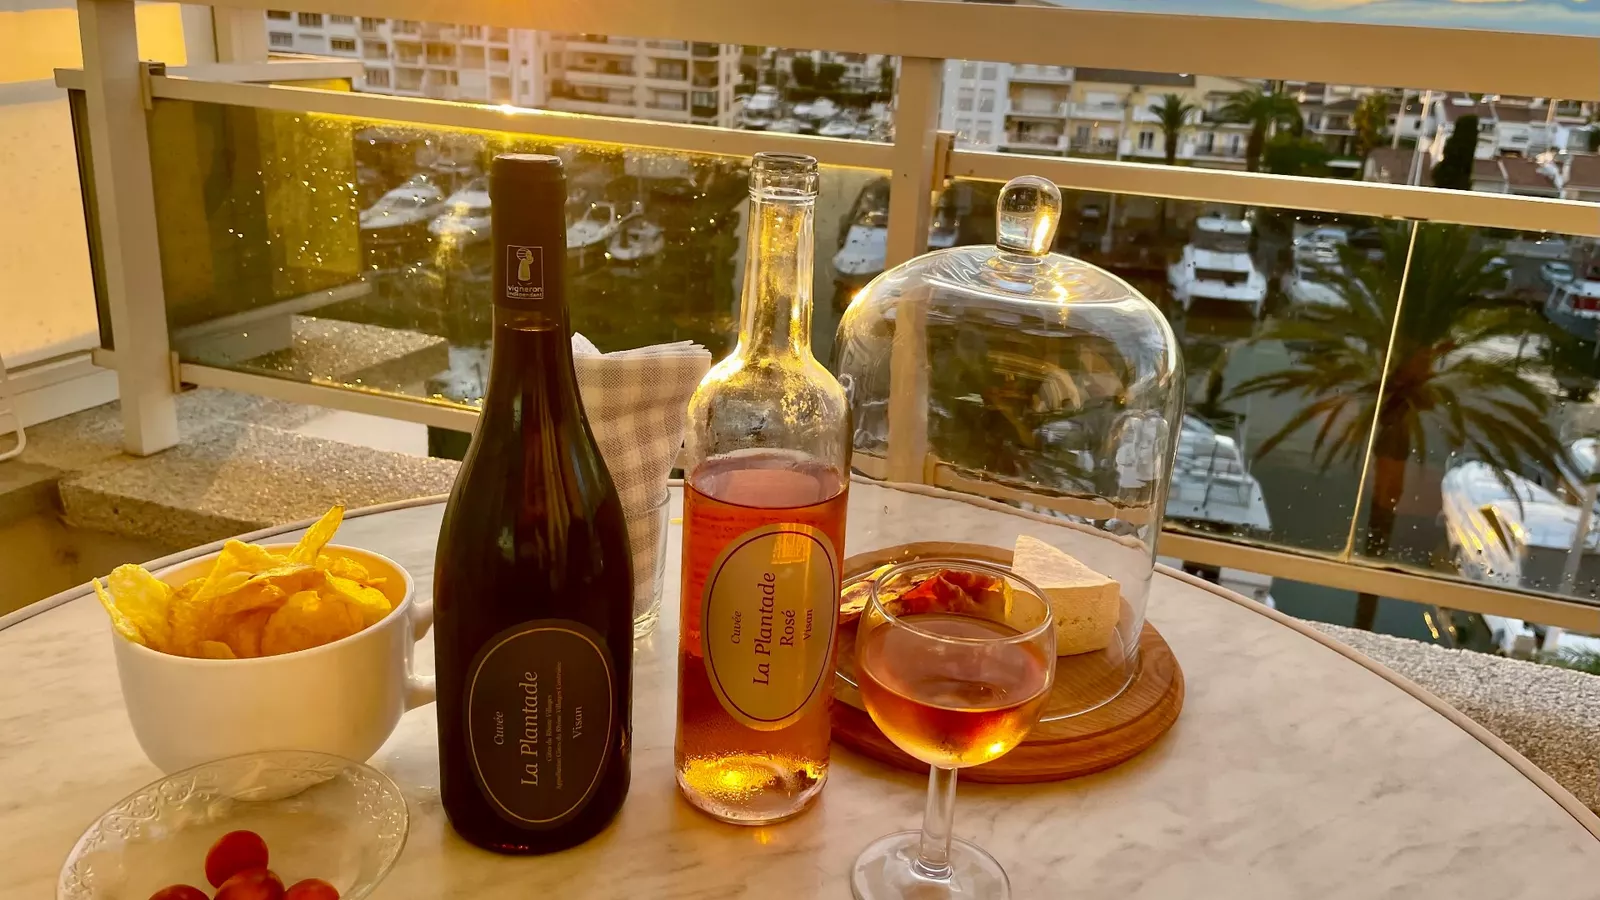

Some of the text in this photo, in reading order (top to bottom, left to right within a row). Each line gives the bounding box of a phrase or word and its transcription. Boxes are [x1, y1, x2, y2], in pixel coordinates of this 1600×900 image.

[507, 285, 543, 293] vigneron
[730, 610, 742, 644] Cuvée
[753, 572, 776, 686] La Plantade
[780, 609, 795, 647] Rosé
[803, 608, 813, 641] Visan
[493, 710, 504, 746] Cuvée
[518, 671, 538, 786] La Plantade
[572, 705, 583, 740] Visan
